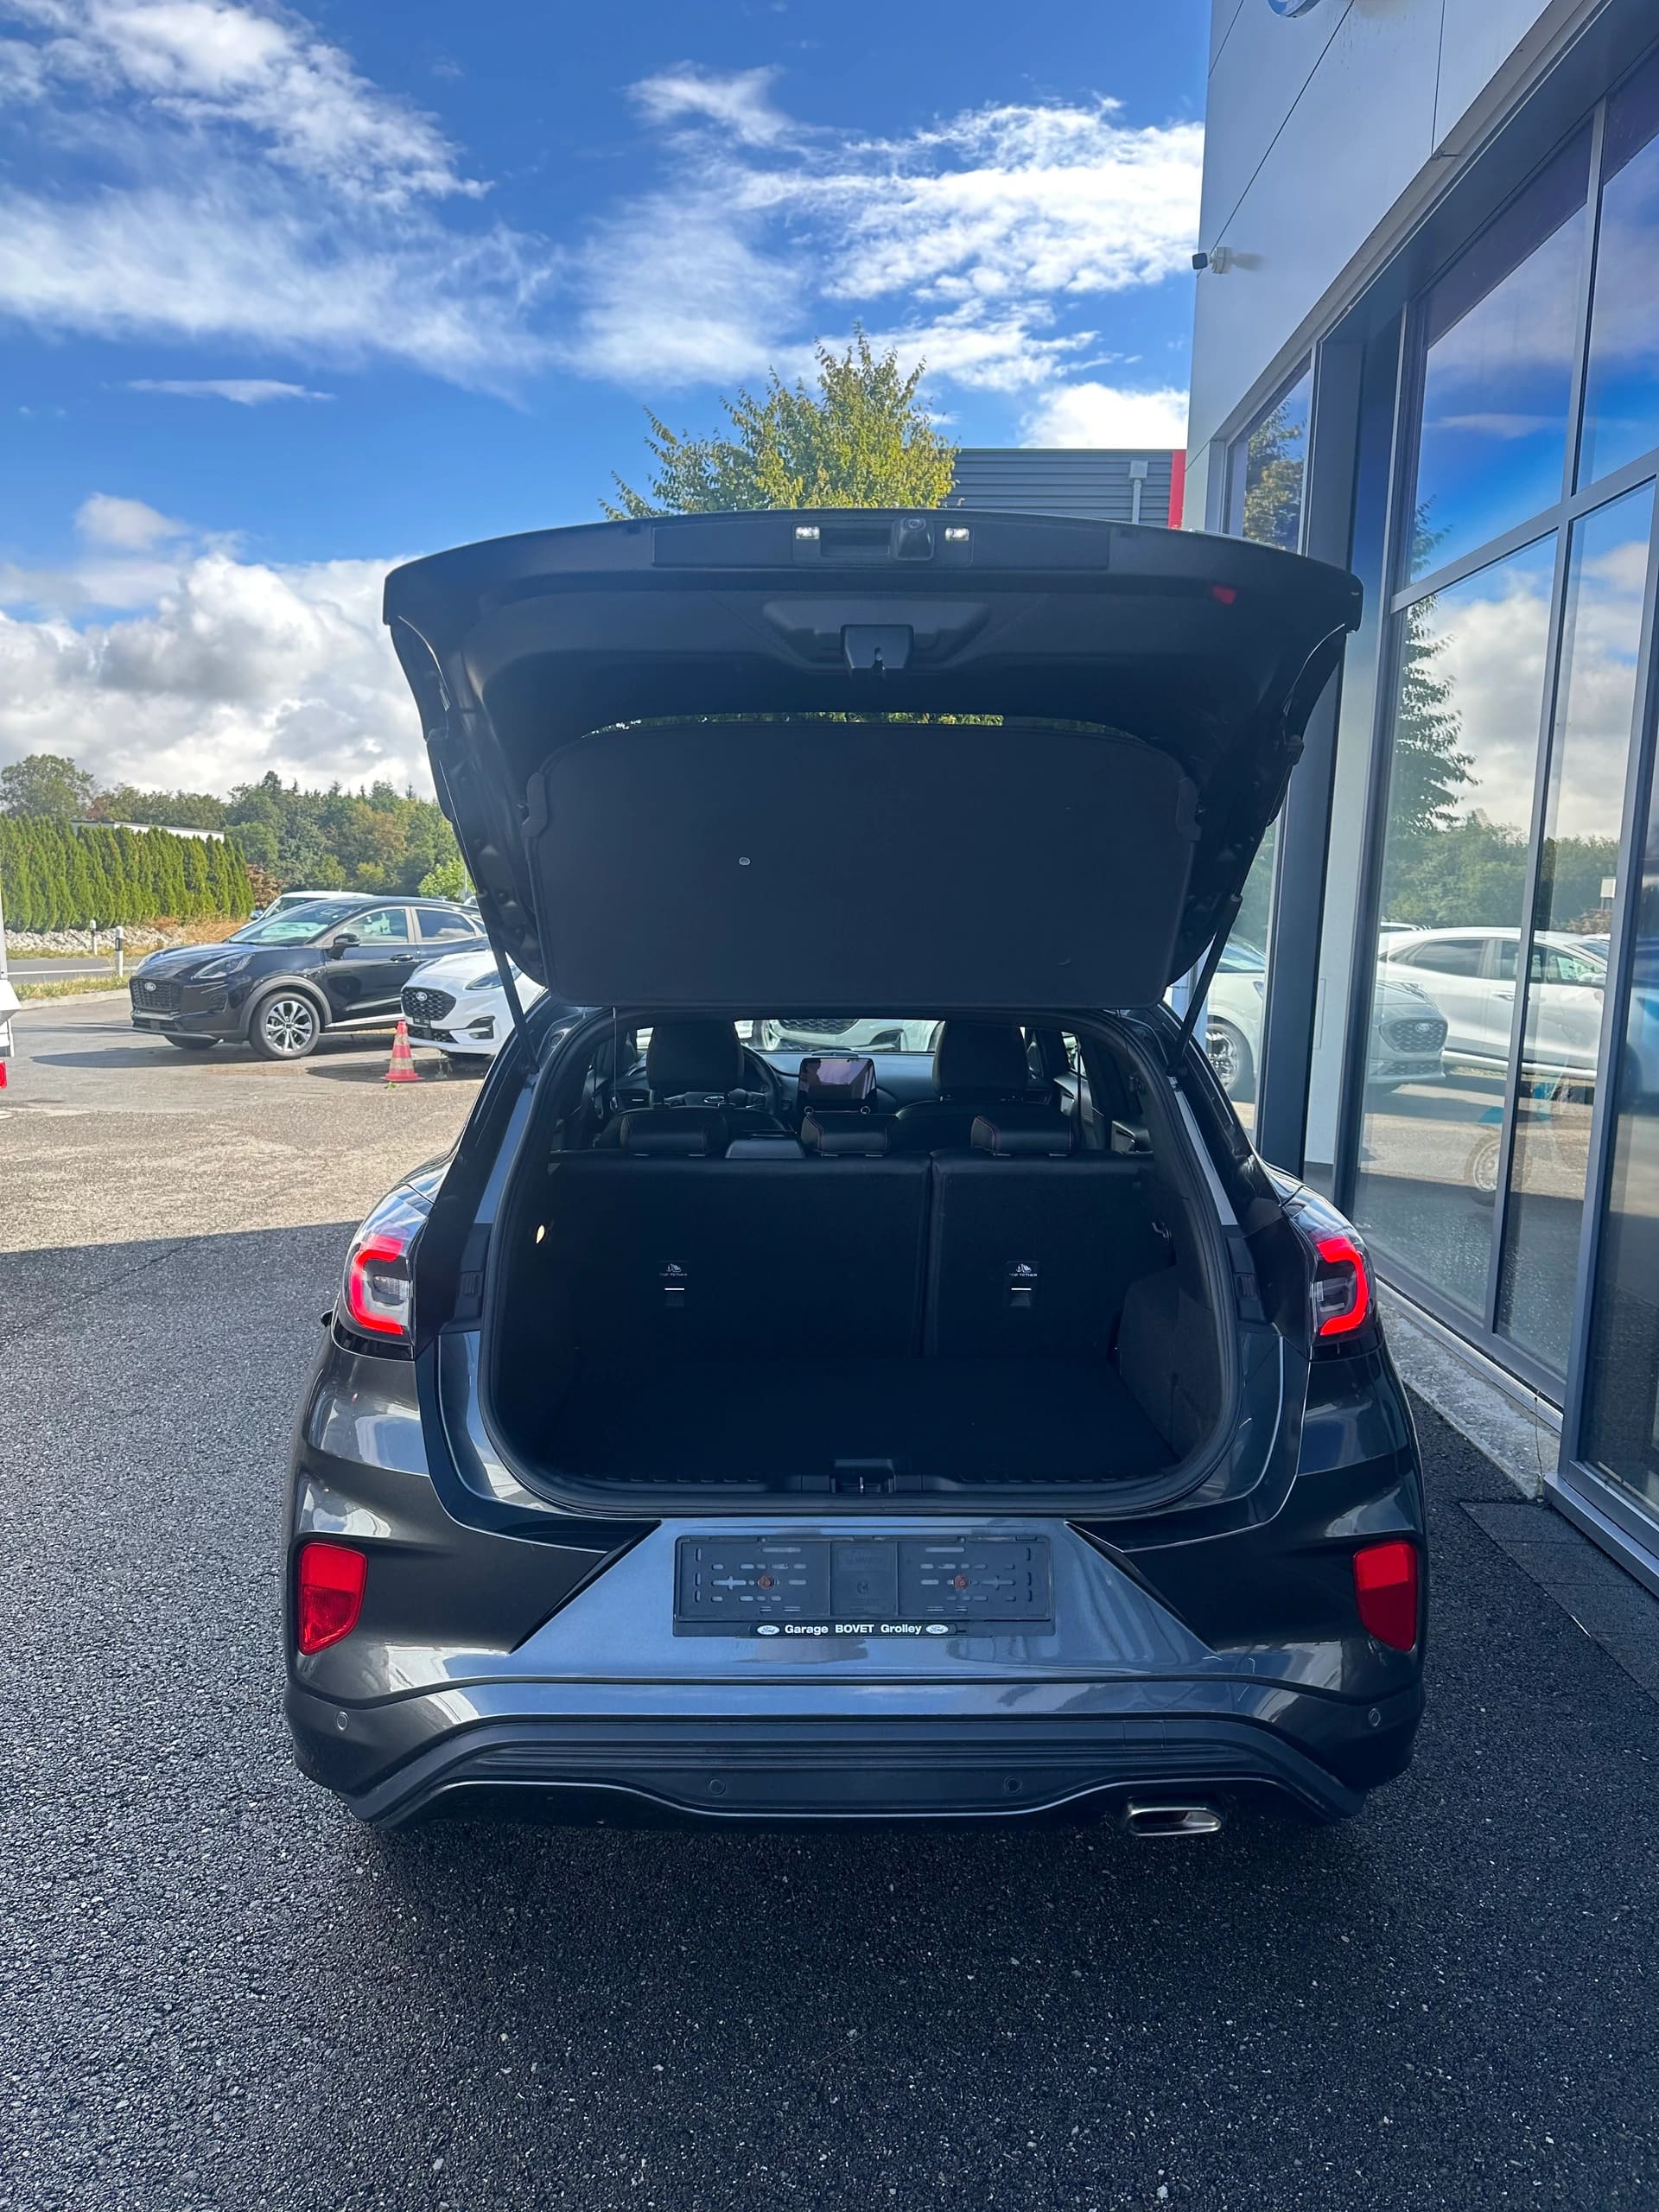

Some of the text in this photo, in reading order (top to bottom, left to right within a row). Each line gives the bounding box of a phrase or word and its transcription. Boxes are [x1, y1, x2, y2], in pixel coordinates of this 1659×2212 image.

[785, 1624, 829, 1636] Garage
[835, 1624, 874, 1633] BOVET
[880, 1624, 922, 1635] Grolley
